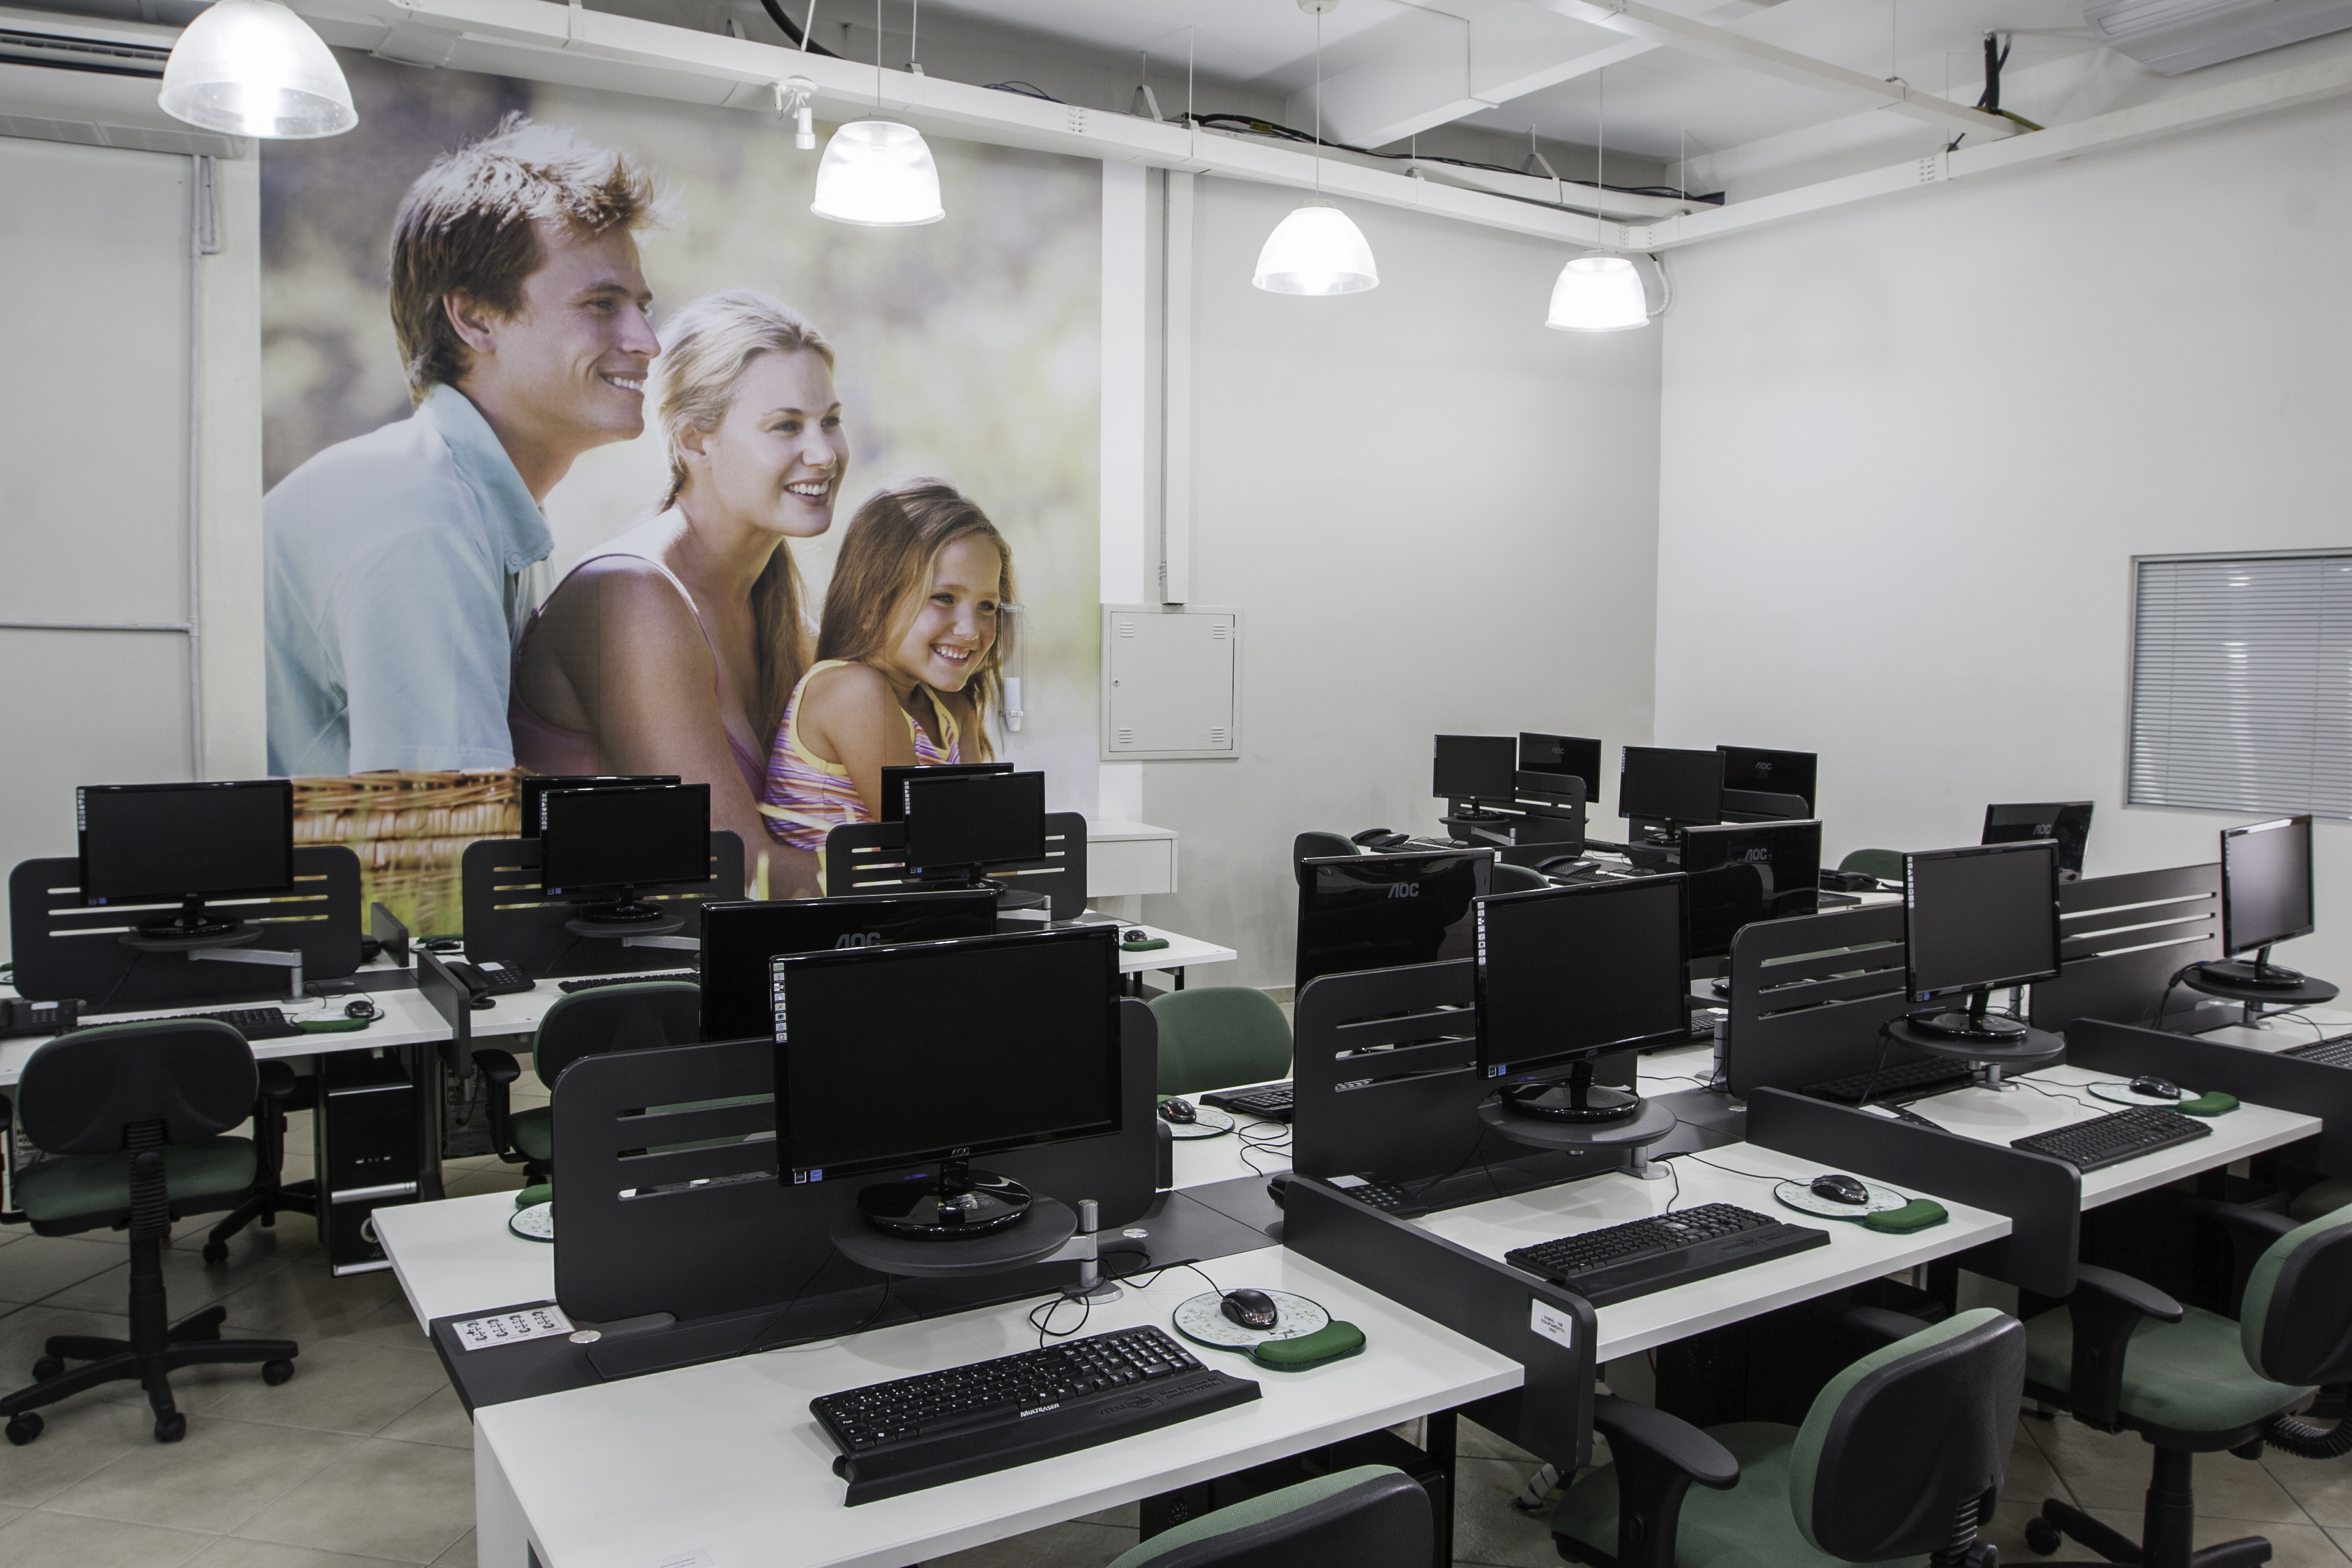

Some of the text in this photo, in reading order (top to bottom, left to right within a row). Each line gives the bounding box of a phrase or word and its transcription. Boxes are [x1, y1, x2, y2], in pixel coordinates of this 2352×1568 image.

[1755, 762, 1772, 770] AOC
[2032, 824, 2052, 835] AOC
[1745, 848, 1767, 861] AOC
[1387, 883, 1419, 898] AOC
[834, 932, 881, 949] AOC
[951, 1147, 969, 1157] AOC
[1020, 1403, 1059, 1418] MULTILASER
